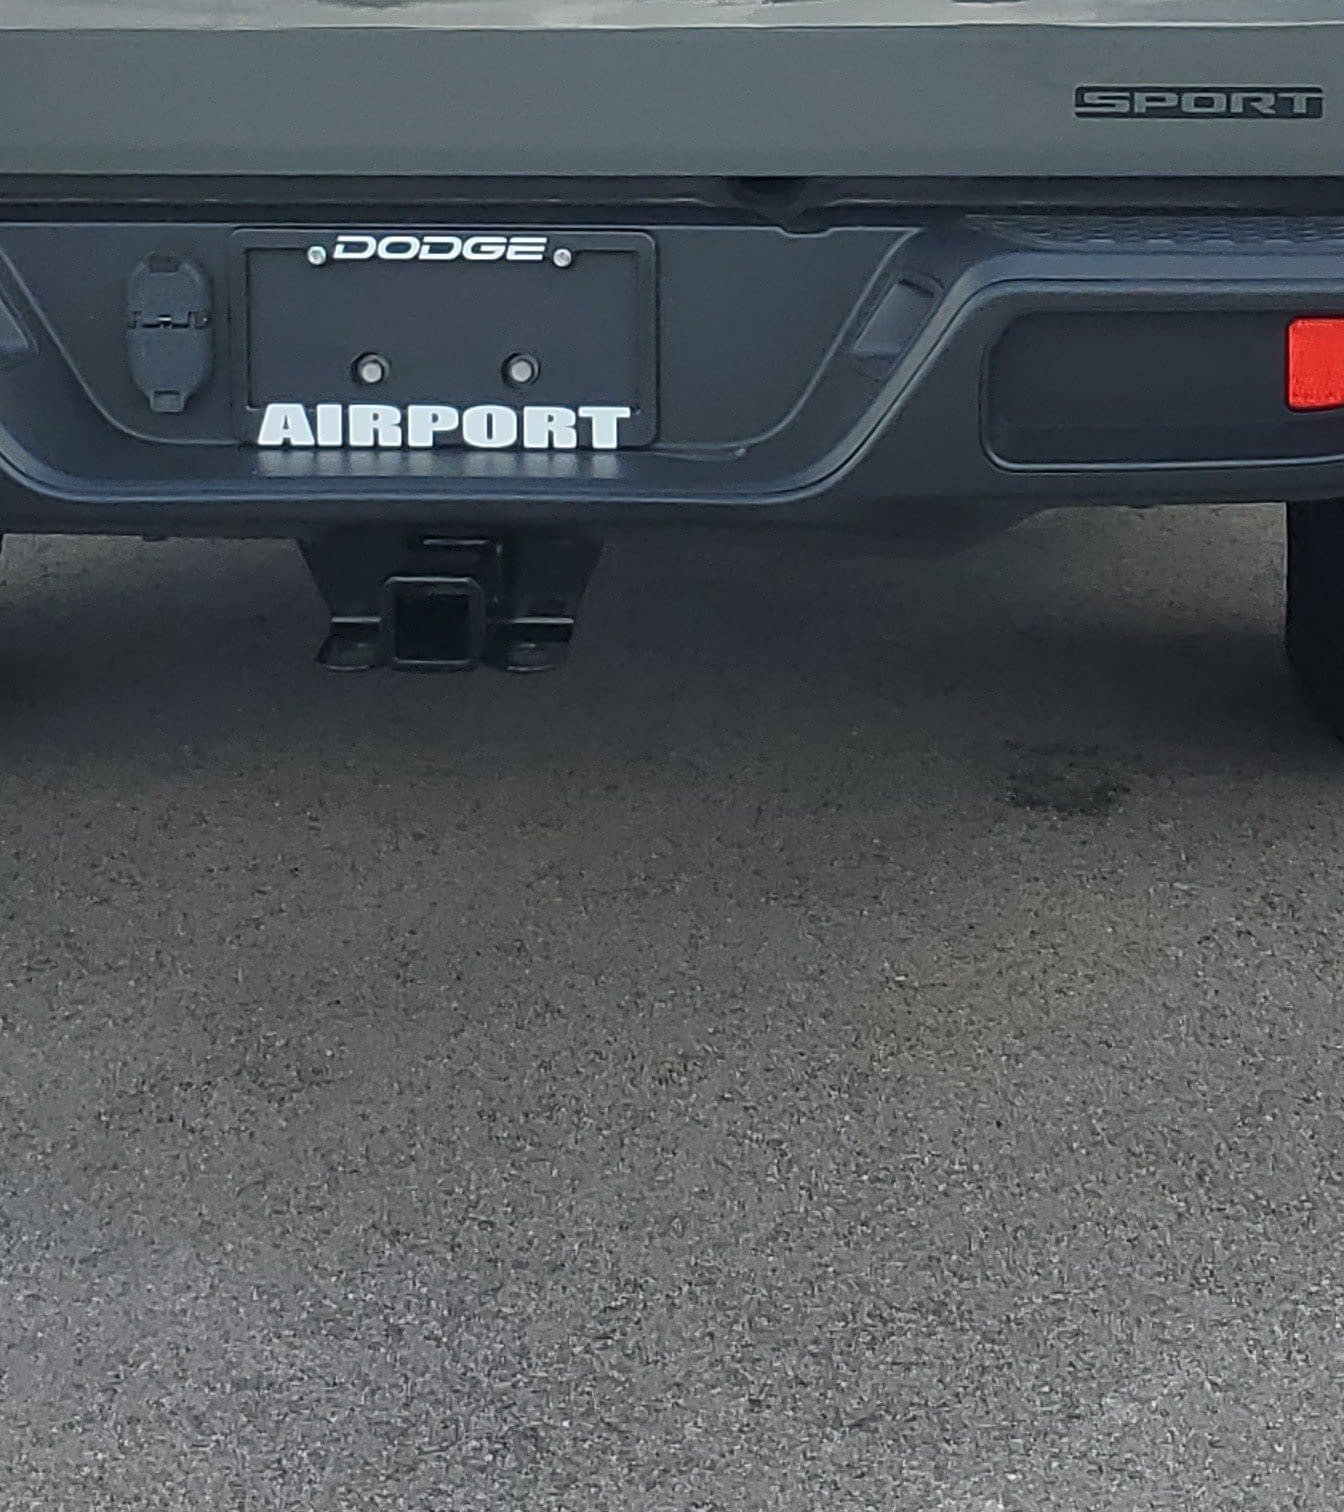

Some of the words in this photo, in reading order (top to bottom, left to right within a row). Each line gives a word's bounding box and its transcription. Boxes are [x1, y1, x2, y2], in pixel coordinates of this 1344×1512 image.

[1074, 90, 1323, 114] SPORT
[333, 235, 549, 261] DODGE
[258, 402, 632, 449] AIRPORT
